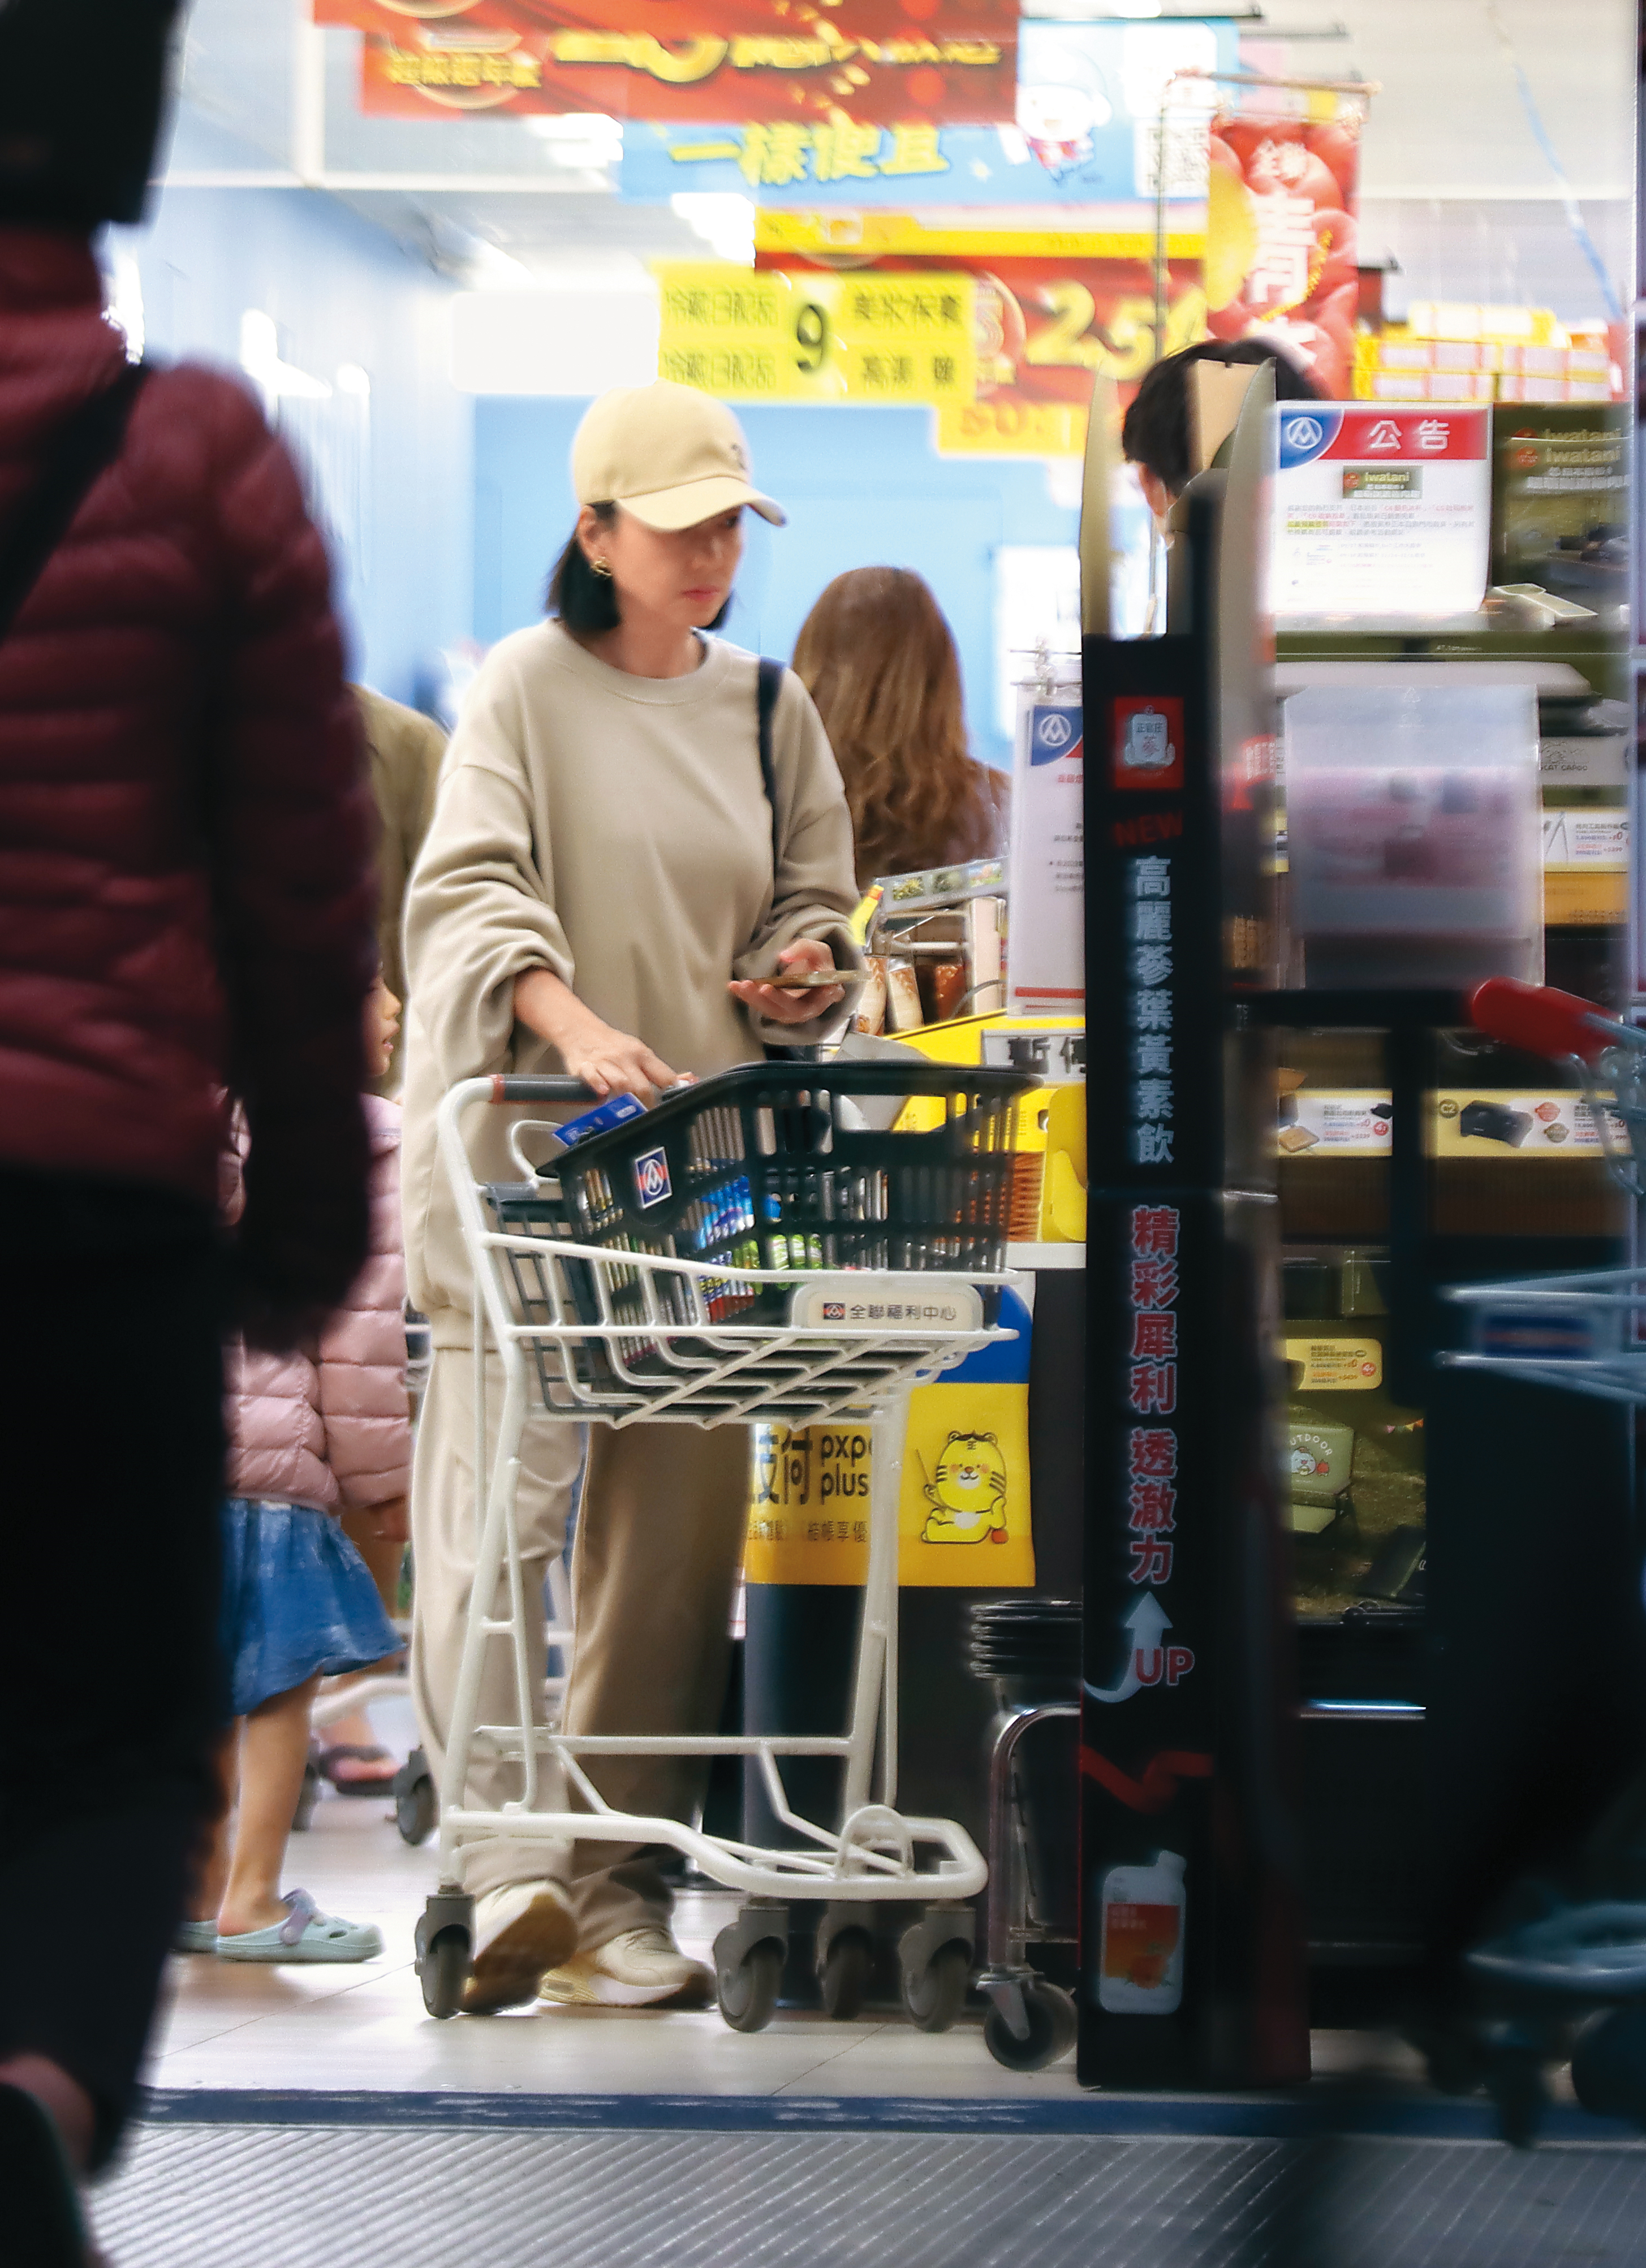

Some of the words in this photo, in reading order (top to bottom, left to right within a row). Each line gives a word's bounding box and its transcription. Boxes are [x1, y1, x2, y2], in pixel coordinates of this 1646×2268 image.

[796, 303, 829, 375] 9
[1369, 419, 1450, 450] 公告
[1113, 810, 1184, 846] NEW
[1131, 1205, 1181, 1415] 精彩犀利
[1290, 1433, 1333, 1456] UTDOOR
[820, 1463, 869, 1505] plus
[1134, 1646, 1196, 1687] UP
